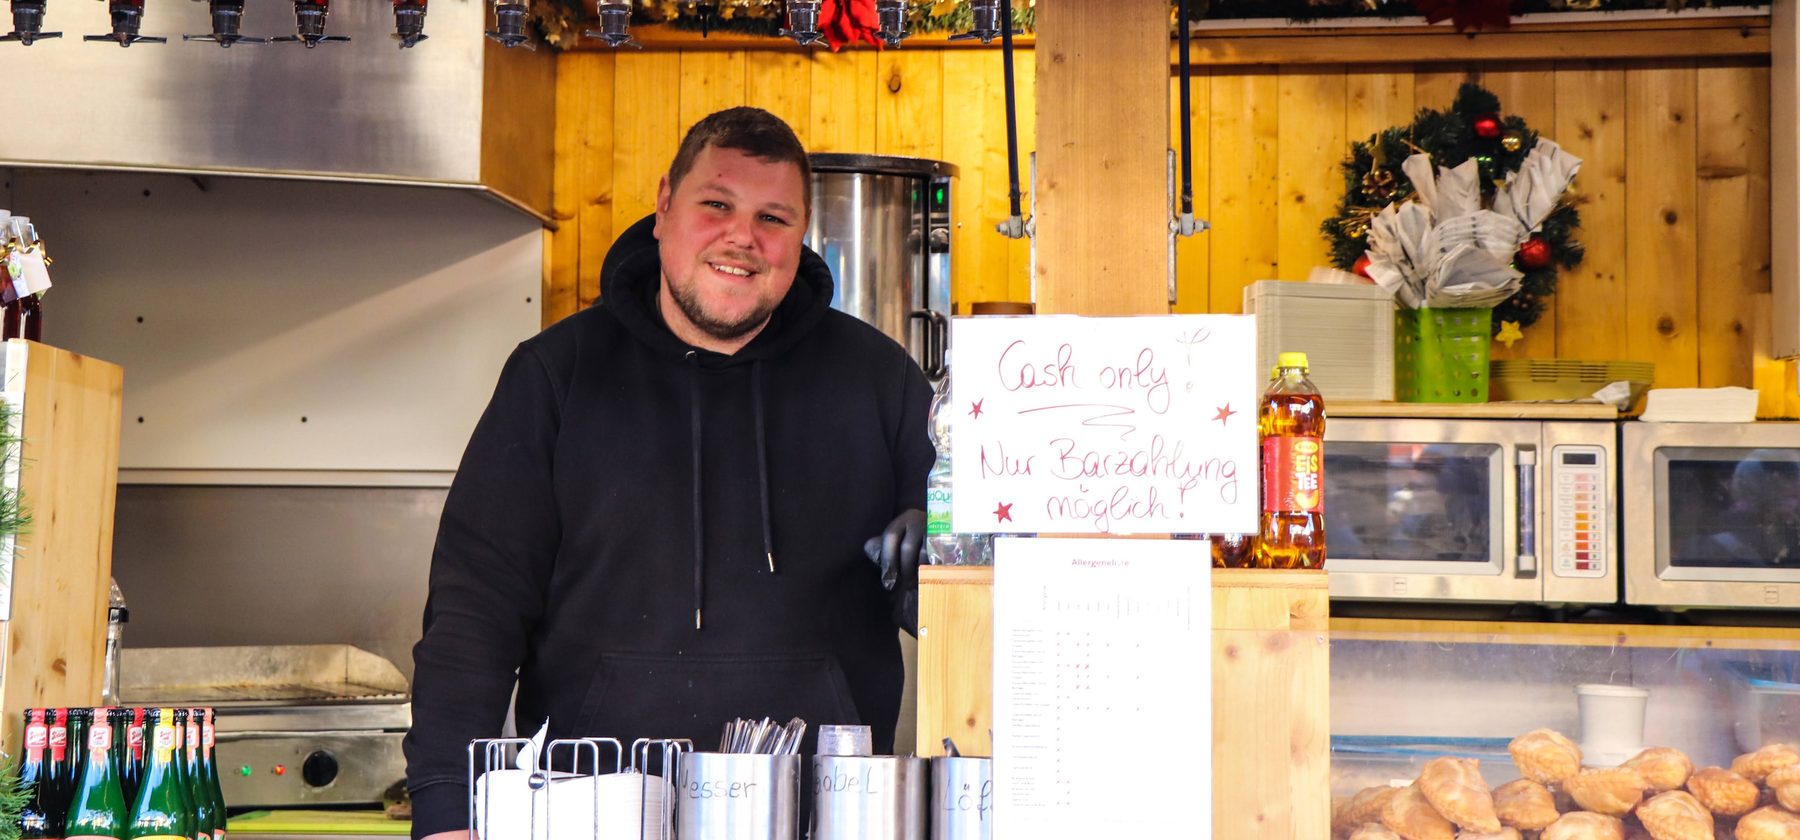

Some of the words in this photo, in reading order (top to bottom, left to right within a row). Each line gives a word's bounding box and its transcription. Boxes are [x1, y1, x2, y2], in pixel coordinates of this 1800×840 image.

[998, 339, 1082, 392] Cash
[979, 439, 1038, 480] Nur
[1050, 434, 1239, 504] Barzahlung
[1295, 472, 1318, 490] TEE
[1047, 479, 1198, 533] möglich!
